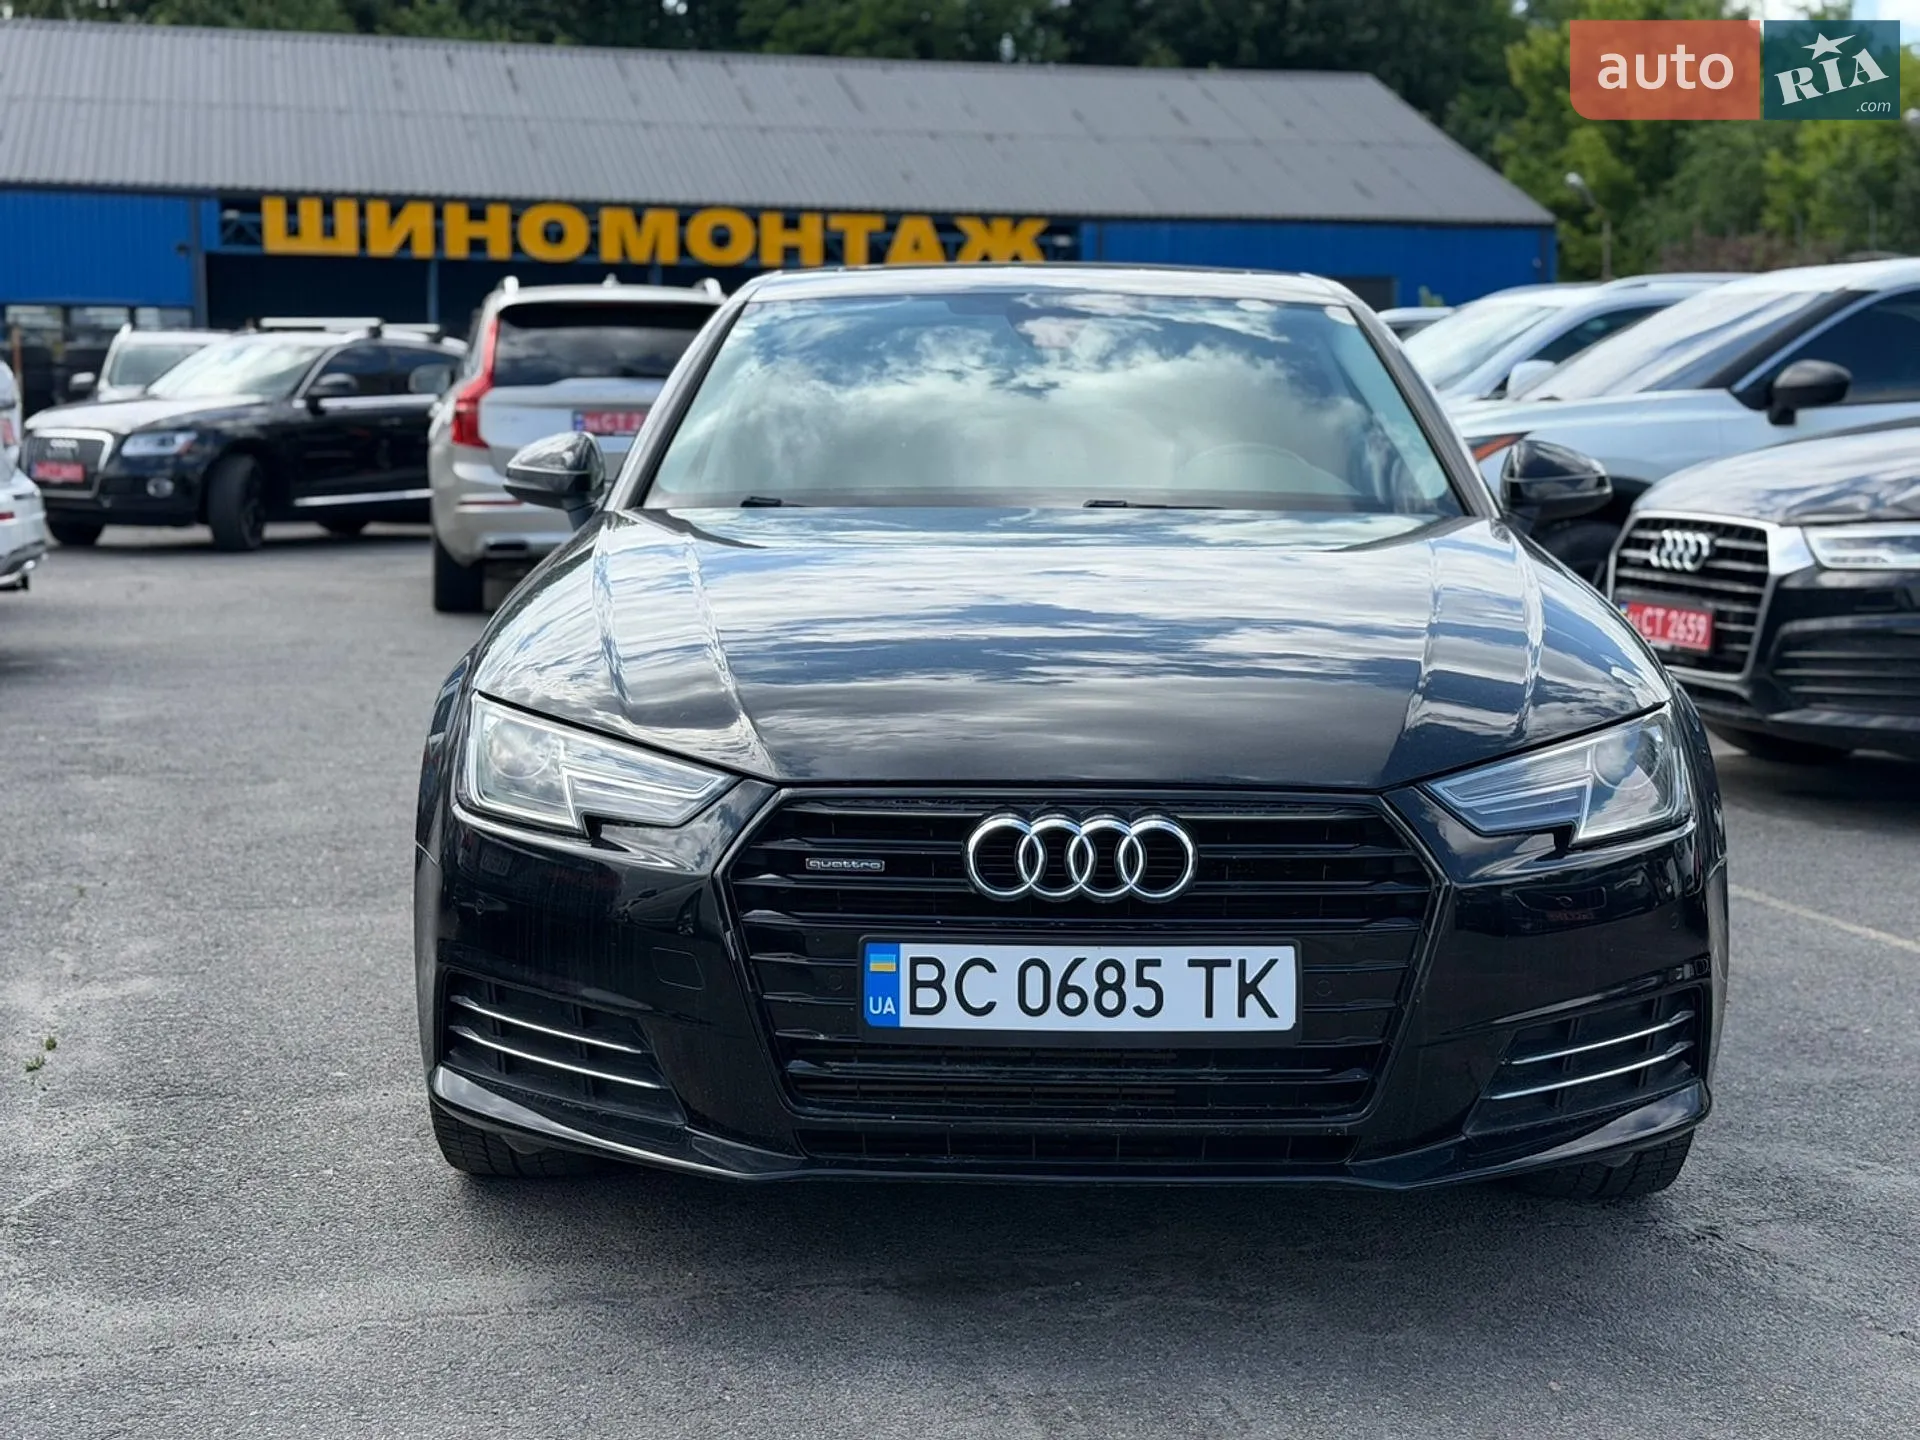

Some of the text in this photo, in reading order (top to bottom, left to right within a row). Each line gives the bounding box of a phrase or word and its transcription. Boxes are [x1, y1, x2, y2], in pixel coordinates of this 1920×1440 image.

[261, 196, 1049, 266] ШИНОМОНТАЖ
[809, 859, 881, 870] quattro
[869, 997, 896, 1015] UA
[908, 956, 1280, 1019] BC 0685 TK
